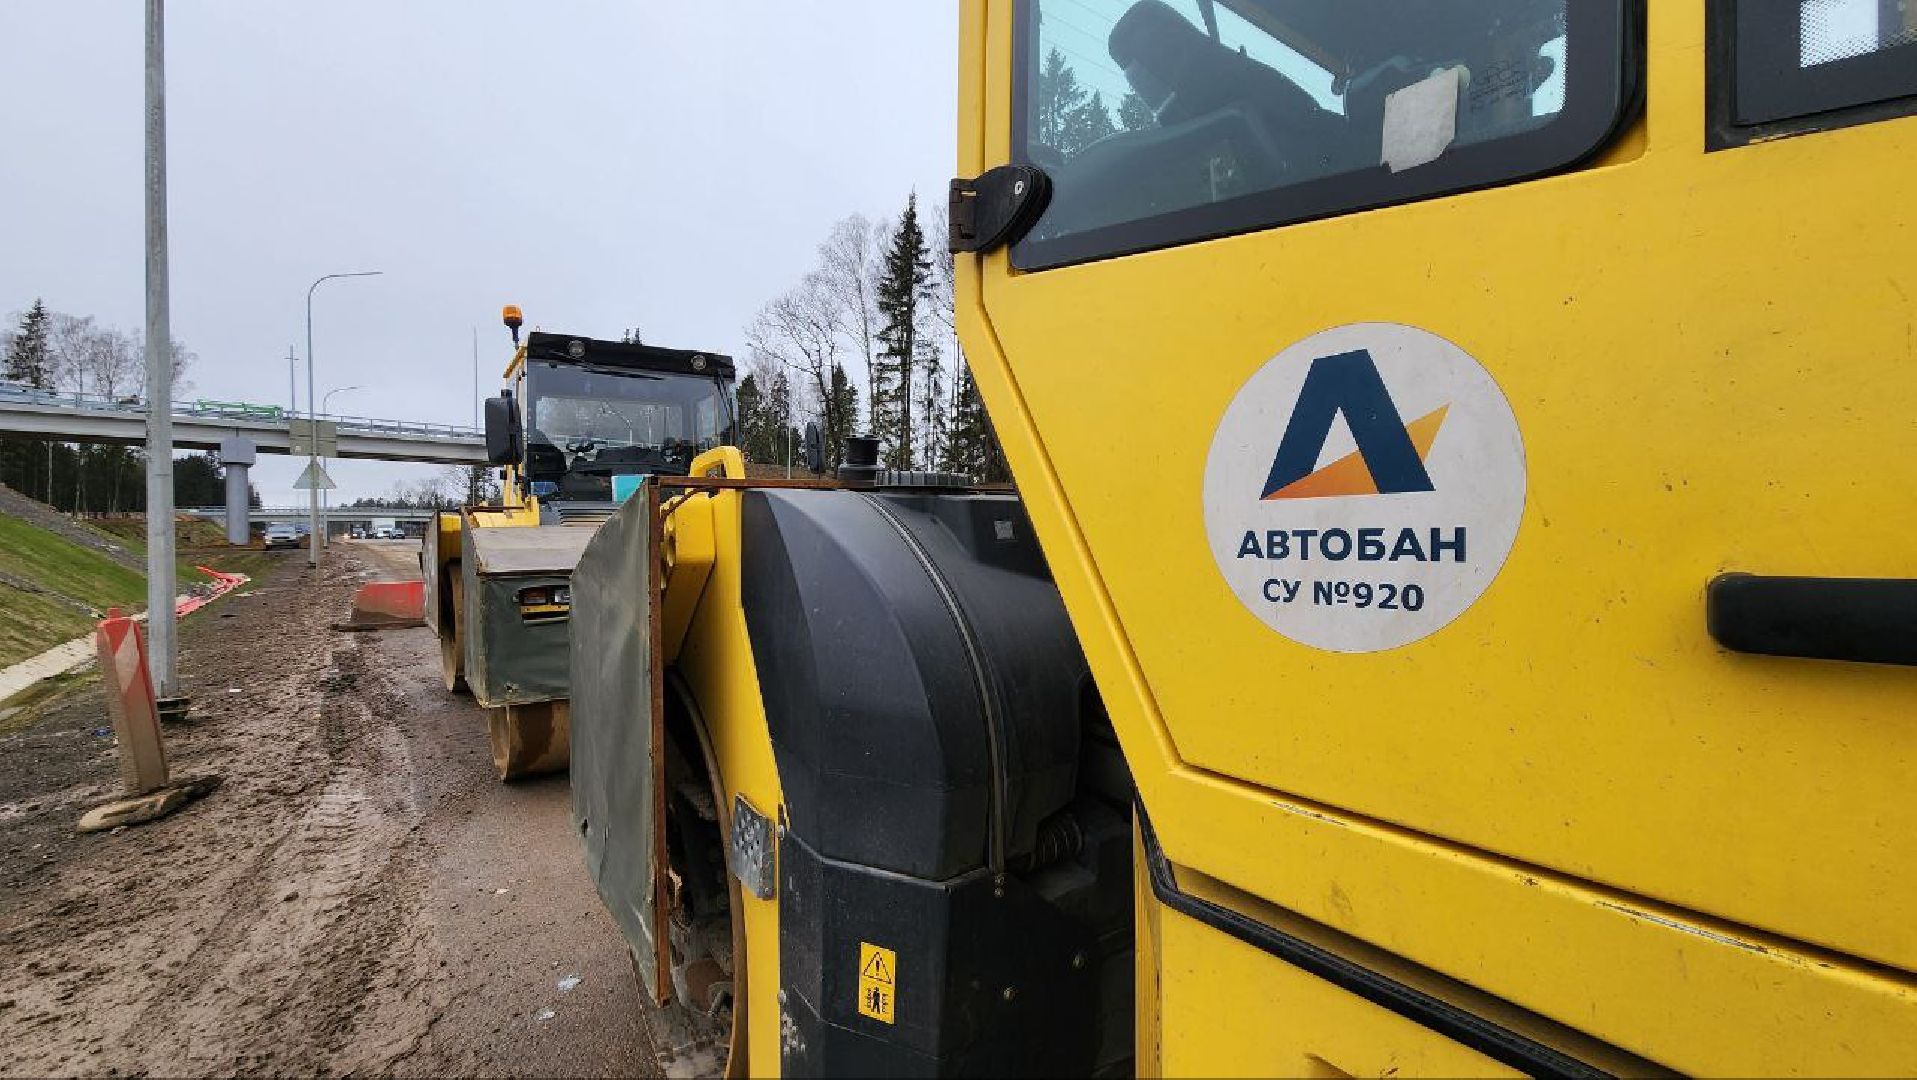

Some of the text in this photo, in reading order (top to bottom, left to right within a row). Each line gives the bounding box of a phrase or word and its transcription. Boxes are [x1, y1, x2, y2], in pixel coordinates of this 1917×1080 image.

[1237, 527, 1467, 563] АВТОБАН
[1263, 579, 1425, 612] СУ №920
